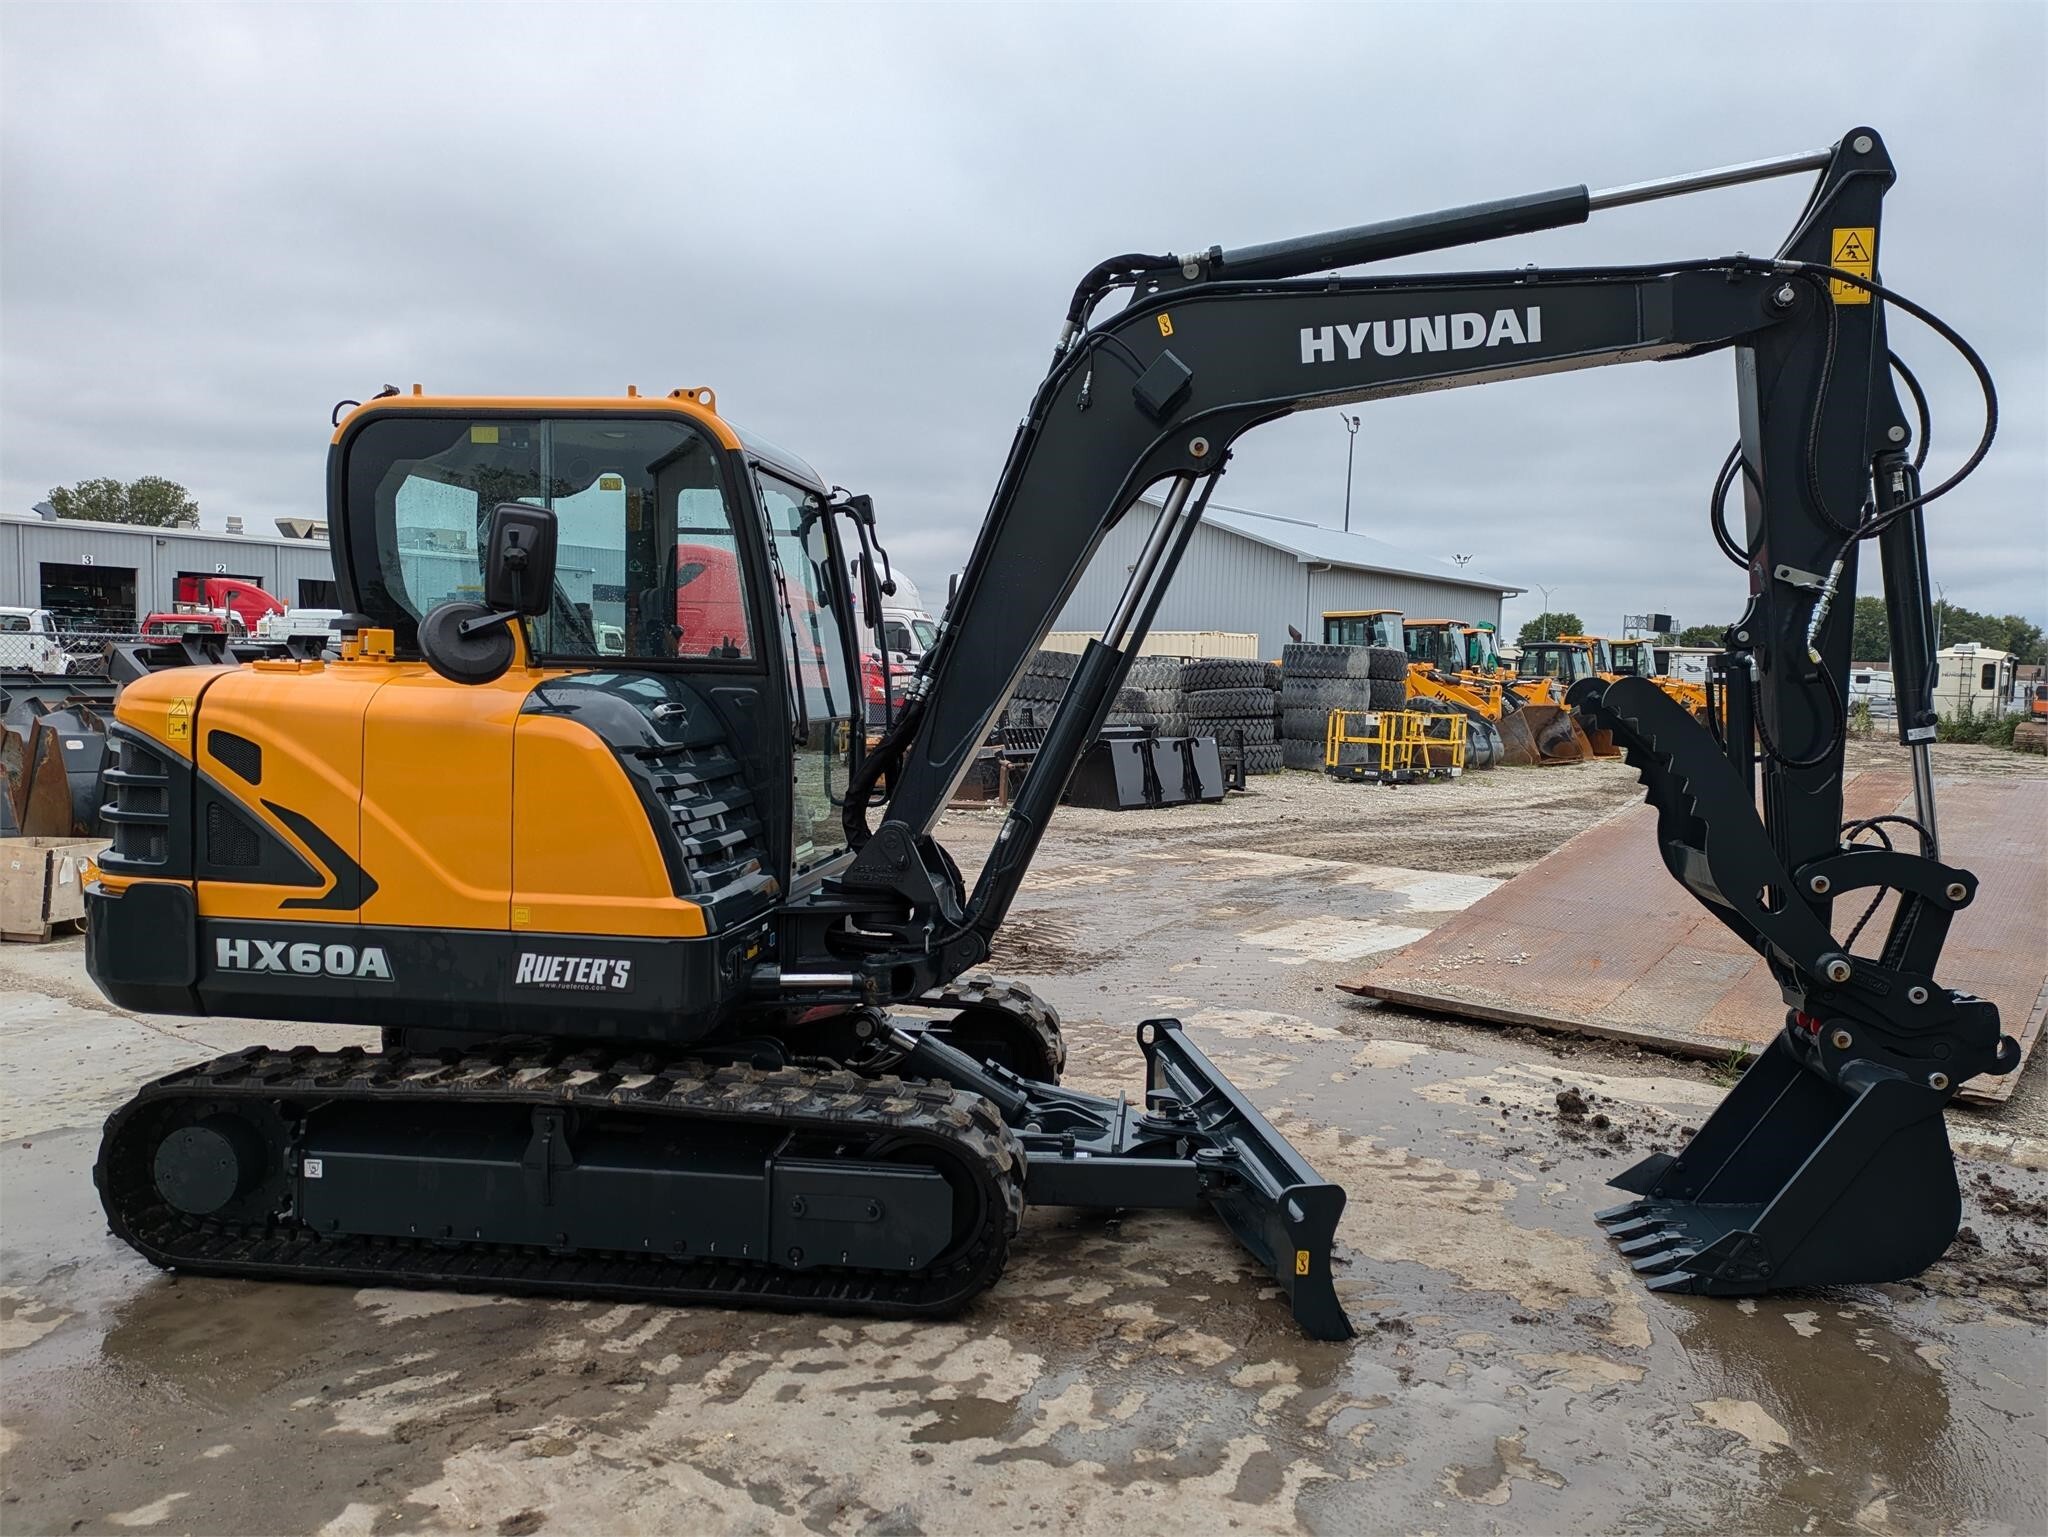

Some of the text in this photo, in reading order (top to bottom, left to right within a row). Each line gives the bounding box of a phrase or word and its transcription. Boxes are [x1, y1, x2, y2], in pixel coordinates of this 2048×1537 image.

[1300, 306, 1542, 364] HYUNDAI
[84, 555, 92, 565] 3
[217, 564, 225, 574] 2
[215, 937, 391, 979] HX60A
[514, 952, 631, 989] RUETER'S
[539, 982, 607, 991] www.rueterco.com
